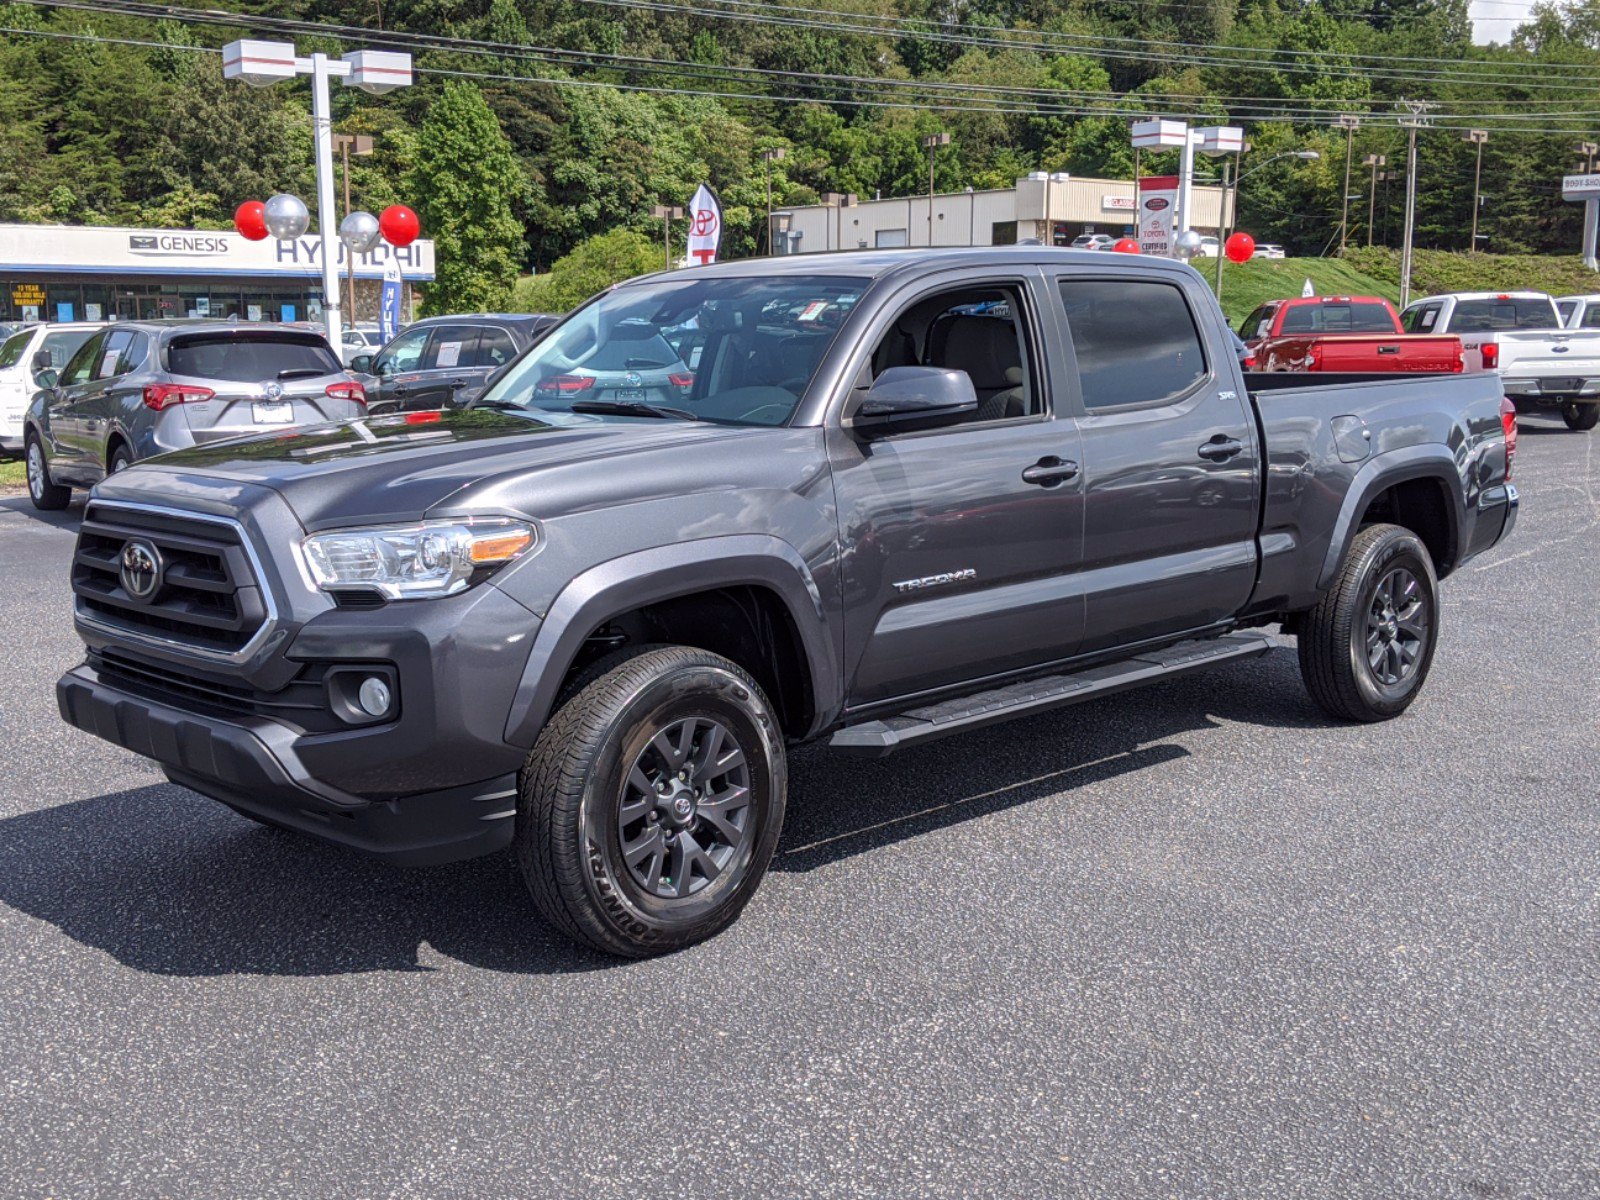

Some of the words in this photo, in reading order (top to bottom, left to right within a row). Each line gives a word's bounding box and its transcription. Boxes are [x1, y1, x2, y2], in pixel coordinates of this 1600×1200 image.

[1585, 177, 1600, 187] SHO
[1143, 230, 1166, 238] TOYOTA
[160, 236, 228, 252] GENESIS
[1142, 242, 1168, 251] CERTIFIED
[276, 239, 421, 268] HYDAI
[1404, 363, 1450, 371] TUNDRA
[892, 568, 977, 592] TACOMA
